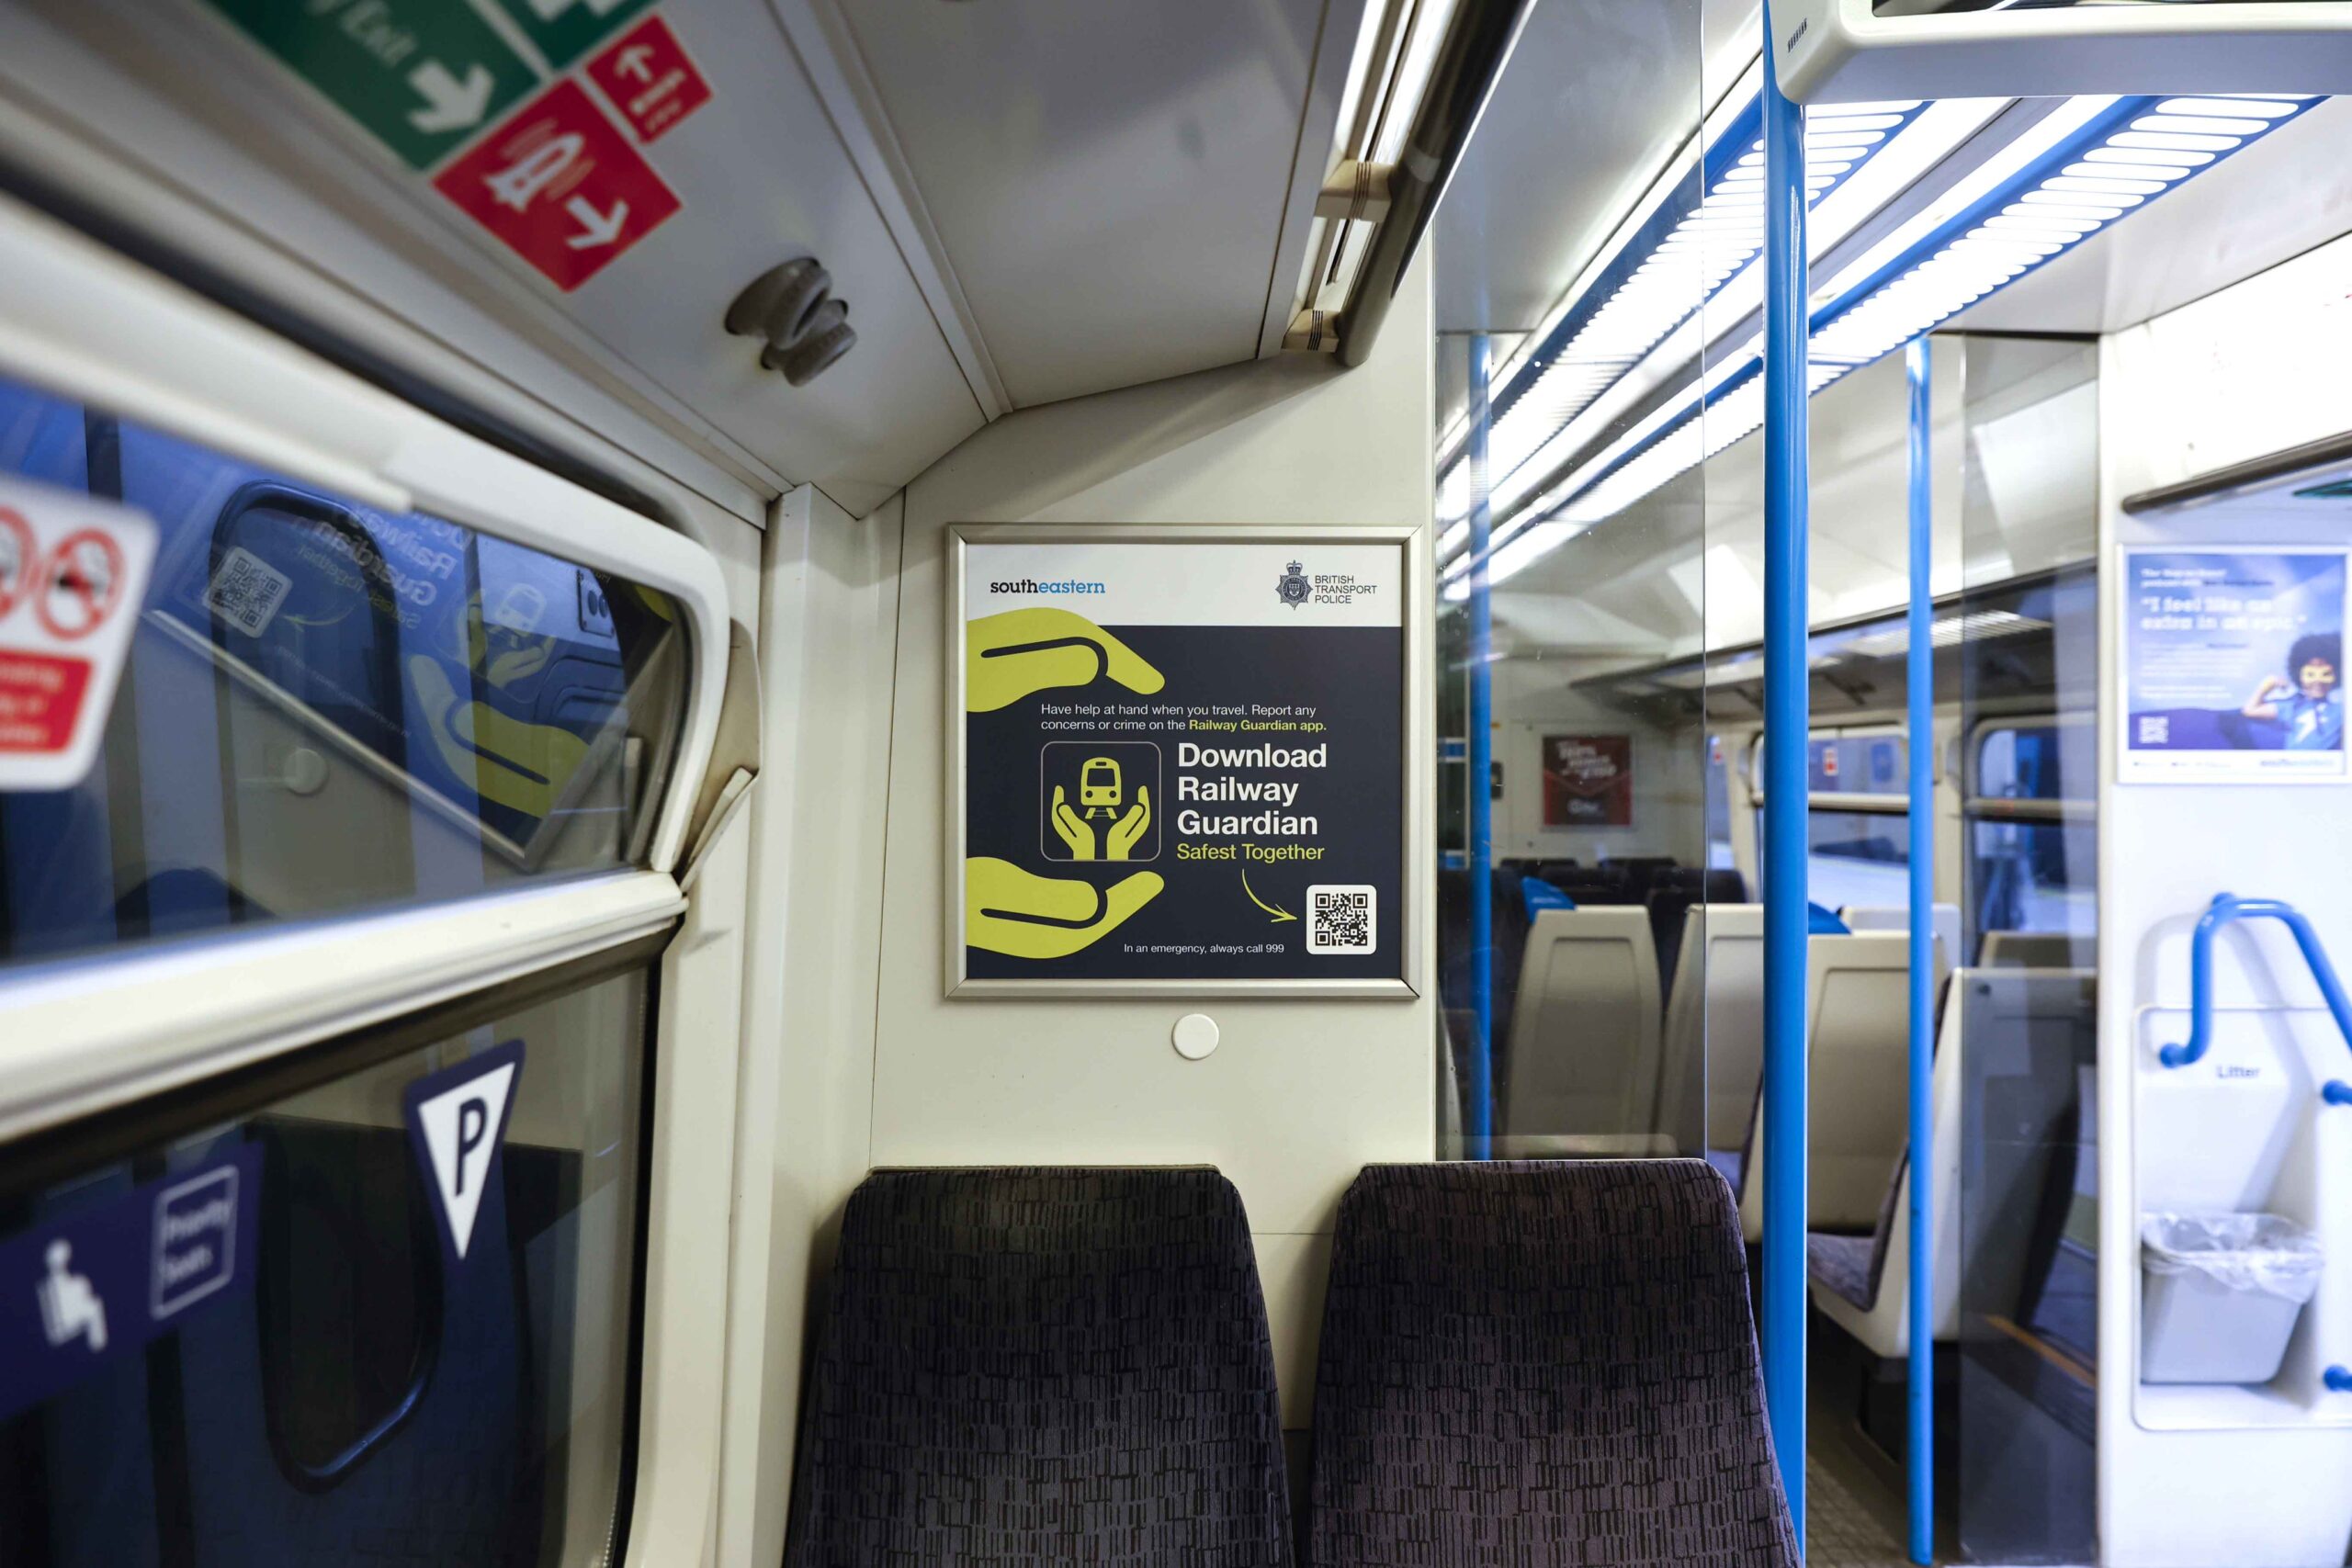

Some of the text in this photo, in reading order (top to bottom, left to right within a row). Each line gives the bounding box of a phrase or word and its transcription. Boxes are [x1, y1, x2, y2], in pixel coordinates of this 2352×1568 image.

[989, 579, 1106, 594] southeastern
[1315, 575, 1354, 584] BRITISH
[1315, 585, 1378, 594] TRANSPORT
[1315, 594, 1352, 604] POLICE
[1041, 703, 1317, 718] Have help at hand when you travel. Report any
[1041, 718, 1328, 734] concerns or crime on the Railway Guardian app.
[1178, 742, 1327, 769] Download
[1178, 775, 1299, 807] Railway
[1177, 810, 1318, 836] Guardian
[1176, 842, 1326, 864] Safest Together
[1124, 943, 1284, 956] In an emergency, always call 999
[2216, 1066, 2260, 1079] Litter
[456, 1098, 488, 1198] P
